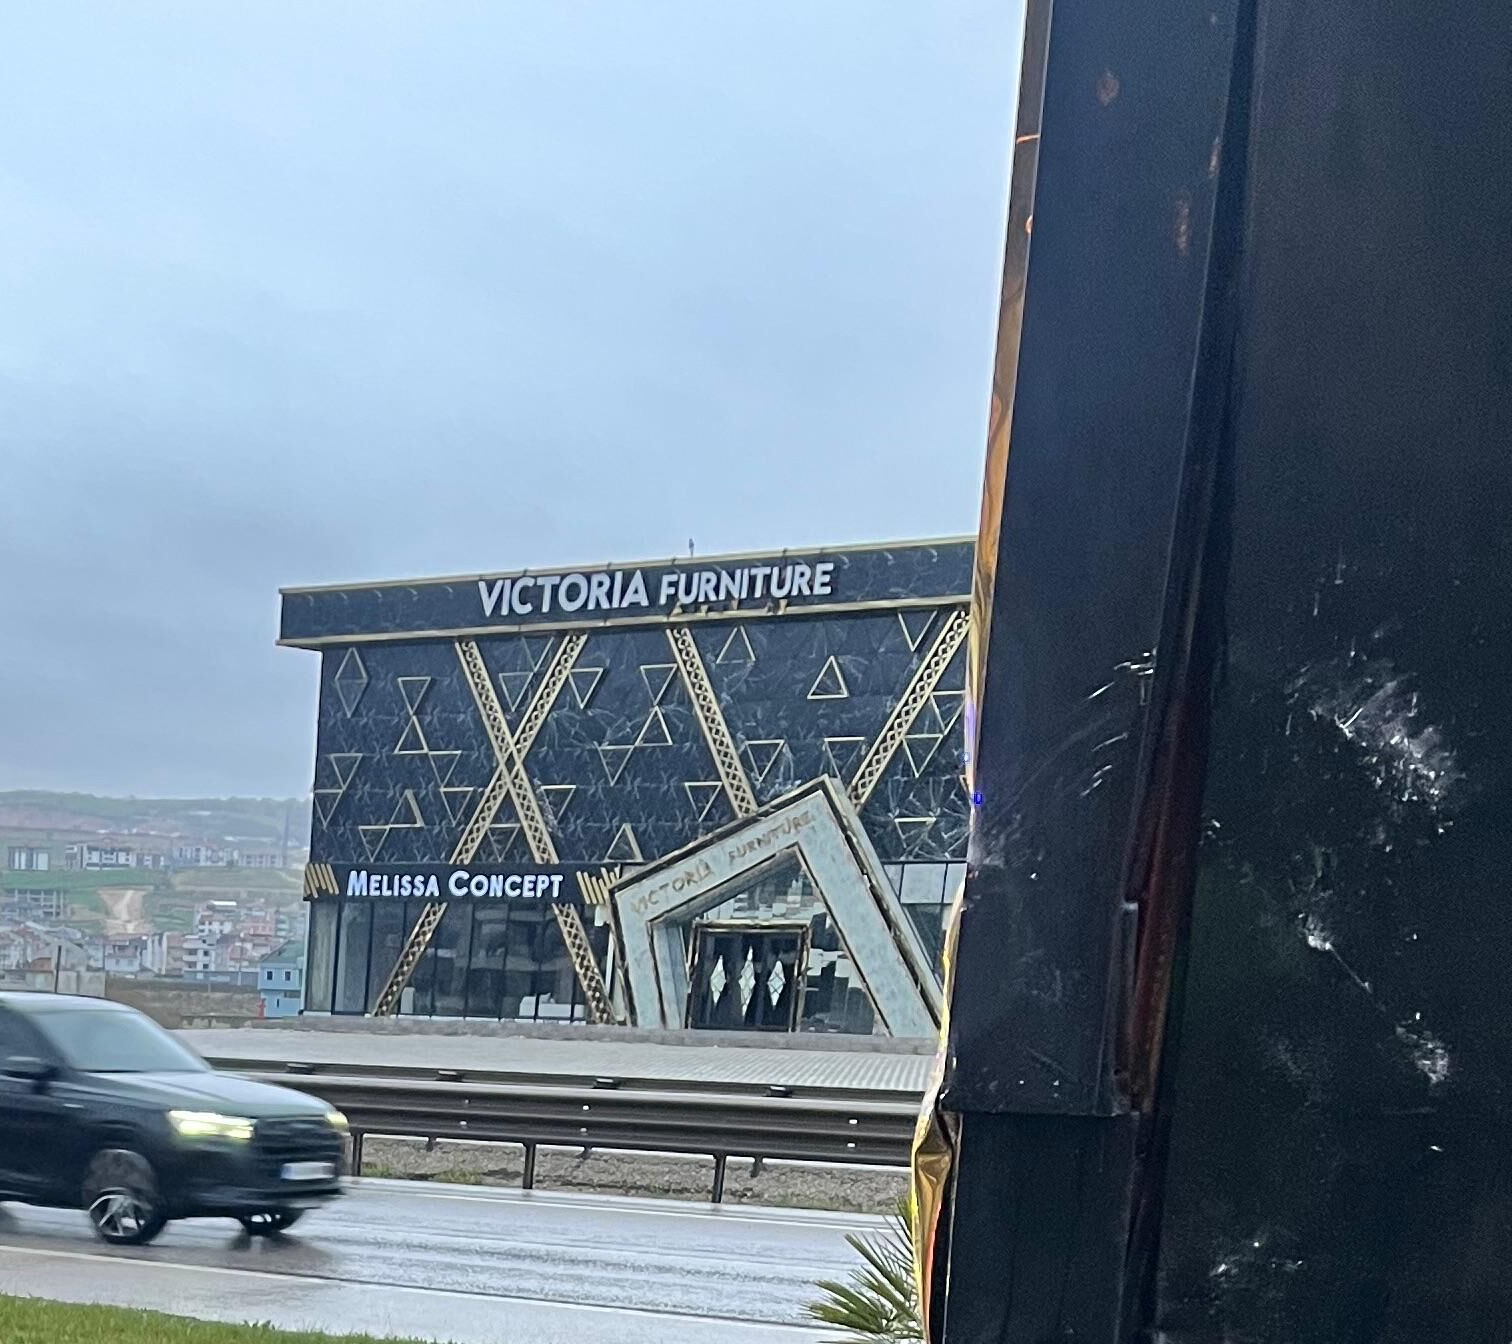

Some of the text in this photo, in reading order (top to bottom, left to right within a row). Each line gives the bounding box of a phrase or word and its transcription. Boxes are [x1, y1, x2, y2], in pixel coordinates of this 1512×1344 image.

[478, 562, 834, 617] VICTORIA FURNITURE
[346, 870, 564, 898] MELISSA CONCEPT
